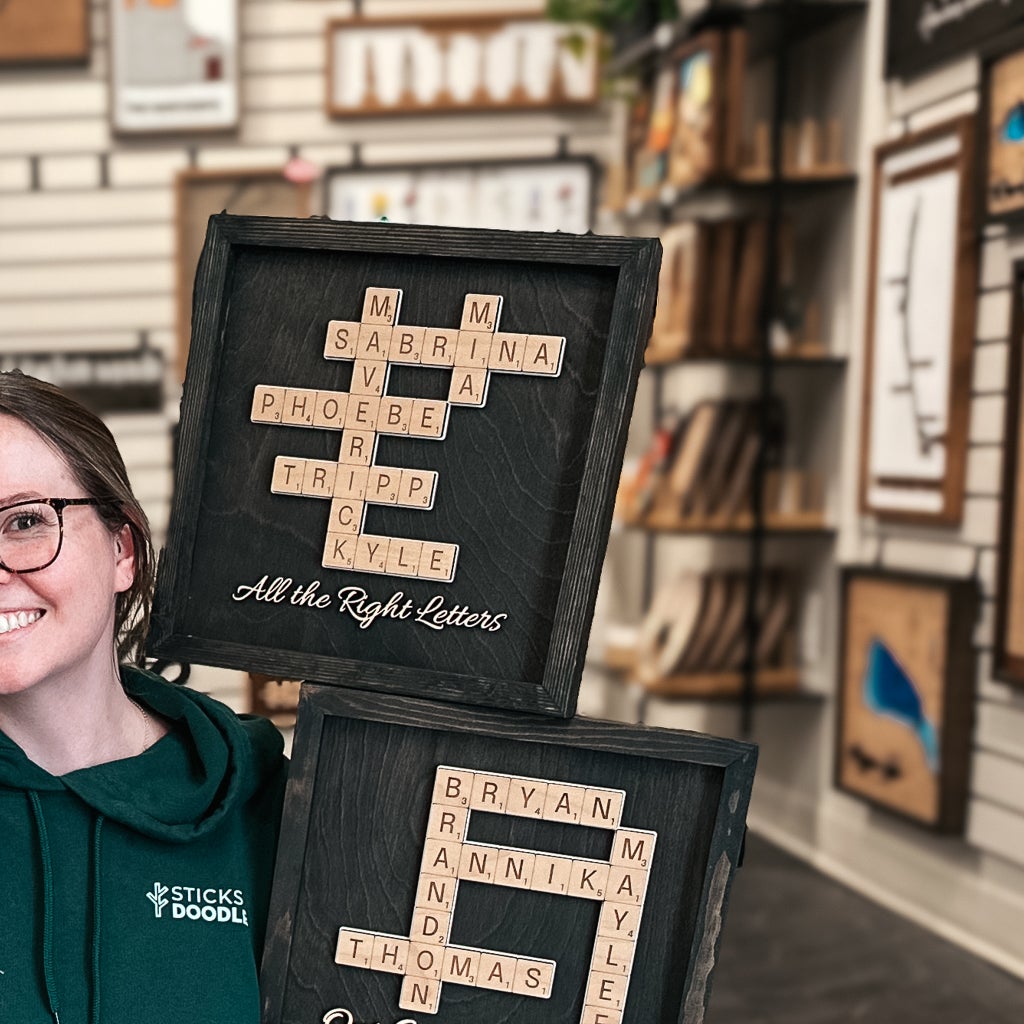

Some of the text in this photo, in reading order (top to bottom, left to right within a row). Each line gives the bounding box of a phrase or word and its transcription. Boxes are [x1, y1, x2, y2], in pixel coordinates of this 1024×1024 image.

[334, 328, 555, 370] SABRINA
[458, 300, 493, 402] MIA
[261, 393, 440, 436] PHOEBE
[332, 294, 394, 567] MAVERICK
[283, 463, 428, 505] TRIPP
[332, 538, 449, 577] KYLE
[232, 575, 508, 632] All the Right Letters
[445, 776, 616, 827] BRYAN
[171, 886, 244, 906] STICKS
[410, 776, 469, 1012] BRANDON
[432, 847, 641, 902] ANNIKA
[349, 938, 547, 996] THOMAS
